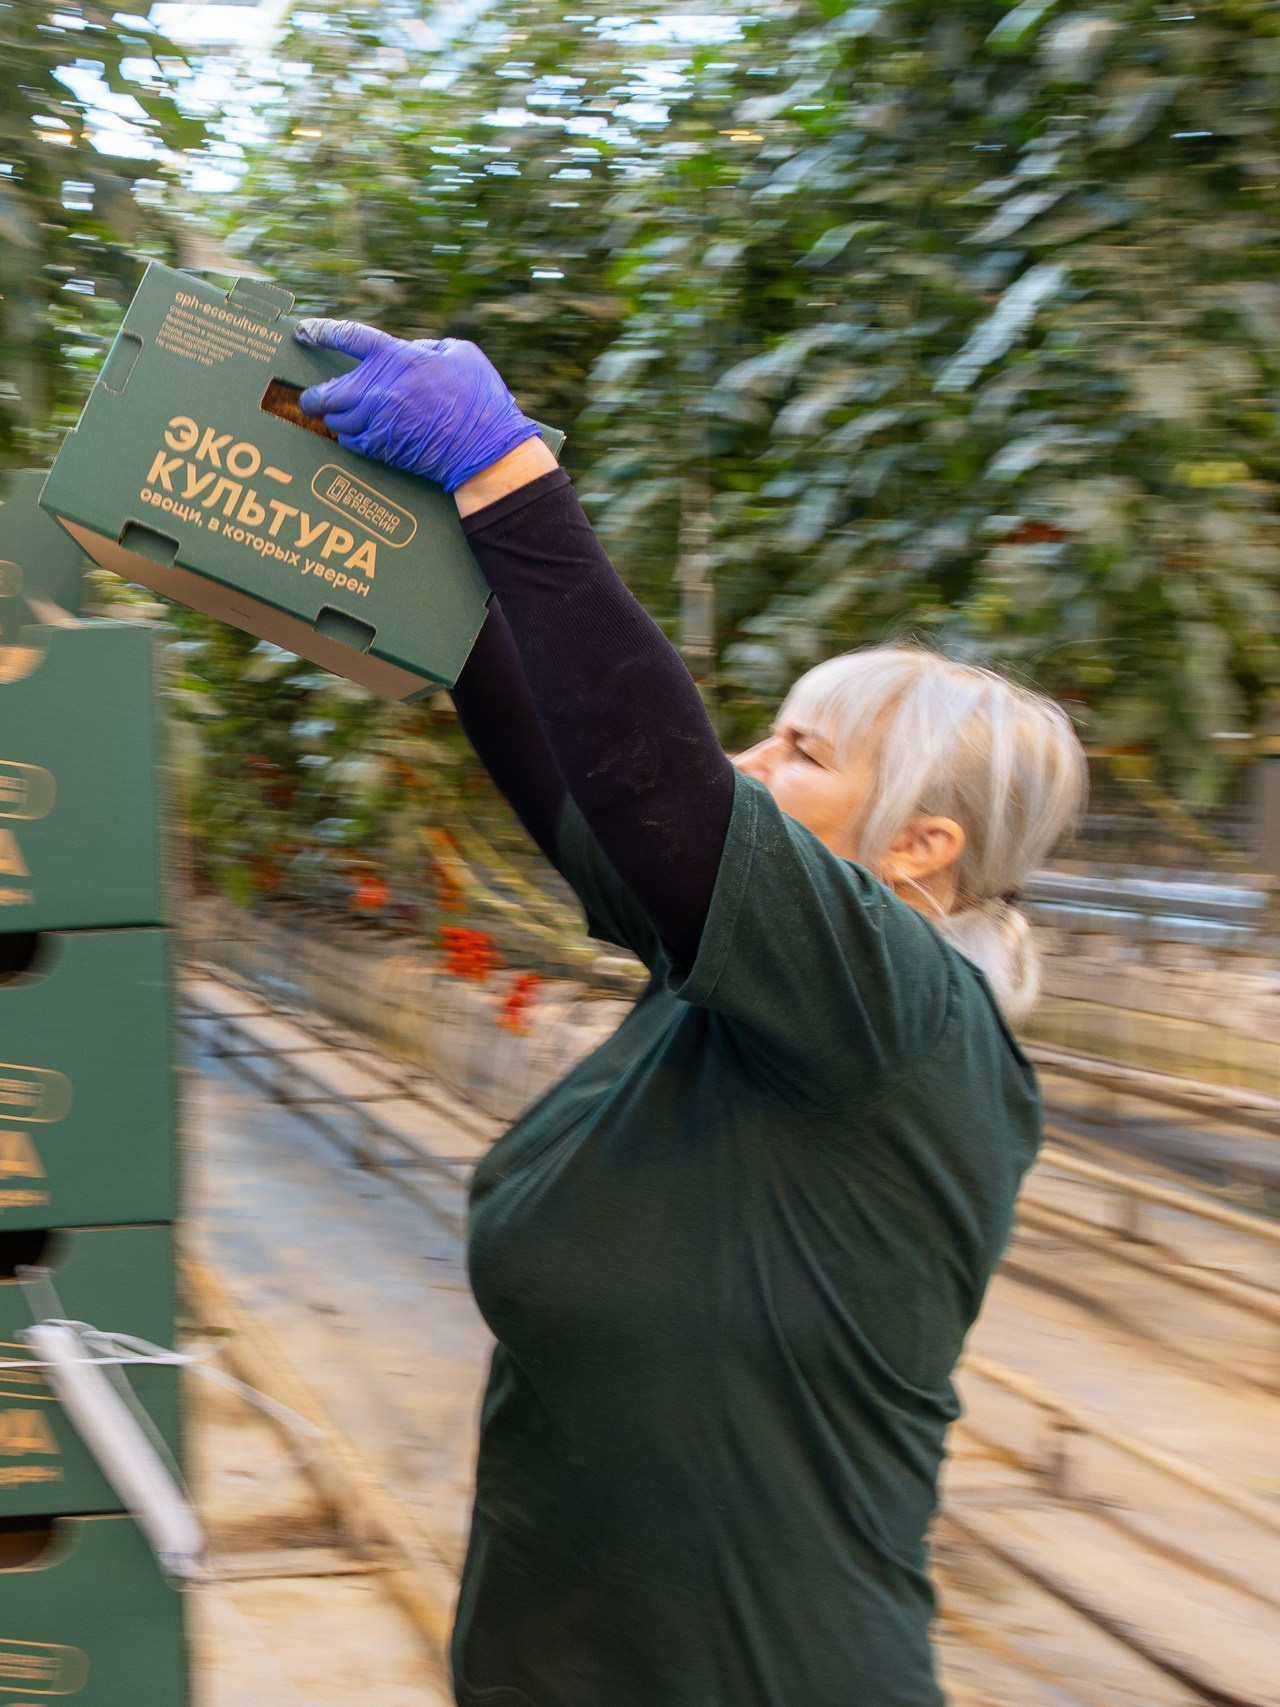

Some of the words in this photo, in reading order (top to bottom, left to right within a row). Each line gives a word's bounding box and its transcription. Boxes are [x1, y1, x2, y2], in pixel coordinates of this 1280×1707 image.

[175, 291, 283, 344] aph-ecoculture.ru
[164, 415, 294, 484] ЭКО-
[146, 449, 378, 579] КУЛЬТУРА
[347, 487, 401, 526] СДЕЛАНО
[140, 488, 203, 527] овощи,
[208, 516, 221, 532] в
[222, 522, 301, 567] которых
[301, 558, 371, 597] уверен
